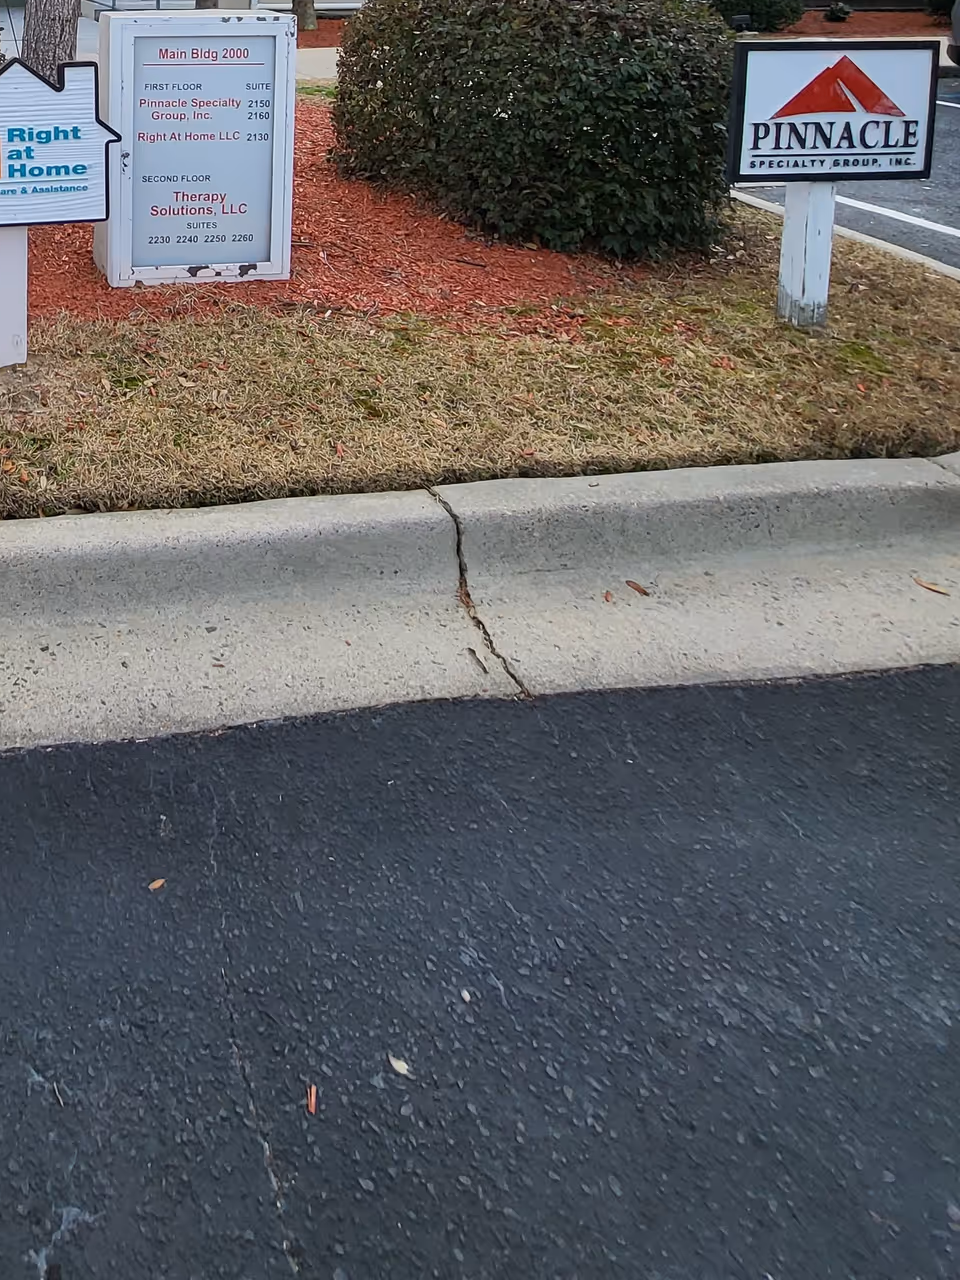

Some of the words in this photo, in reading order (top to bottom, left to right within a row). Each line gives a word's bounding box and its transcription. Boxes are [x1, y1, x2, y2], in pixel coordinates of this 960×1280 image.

[158, 48, 187, 59] Main
[191, 49, 218, 61] Bldg
[222, 48, 249, 58] 2000
[140, 99, 187, 108] Pinnacle
[191, 98, 241, 109] Specialty
[248, 100, 270, 108] 2150
[151, 111, 189, 122] Group,
[193, 111, 213, 120] Inc.
[248, 112, 270, 120] 2160
[7, 126, 81, 143] Right
[138, 132, 167, 143] Right
[169, 132, 181, 141] At
[185, 132, 215, 141] Home
[219, 131, 240, 140] LLC
[247, 133, 269, 141] 2130
[749, 120, 919, 150] PINNACLE
[7, 146, 34, 160] at
[749, 159, 826, 168] SPECIALTY
[889, 158, 916, 166] INC.
[8, 163, 87, 178] Home
[142, 175, 179, 183] SECOND
[31, 185, 88, 193] Assistance
[173, 192, 227, 203] Therapy
[150, 205, 217, 216] Solutions,
[222, 203, 248, 214] LLC
[148, 236, 170, 244] 2230
[204, 235, 226, 243] 2250
[232, 234, 253, 242] 2260
